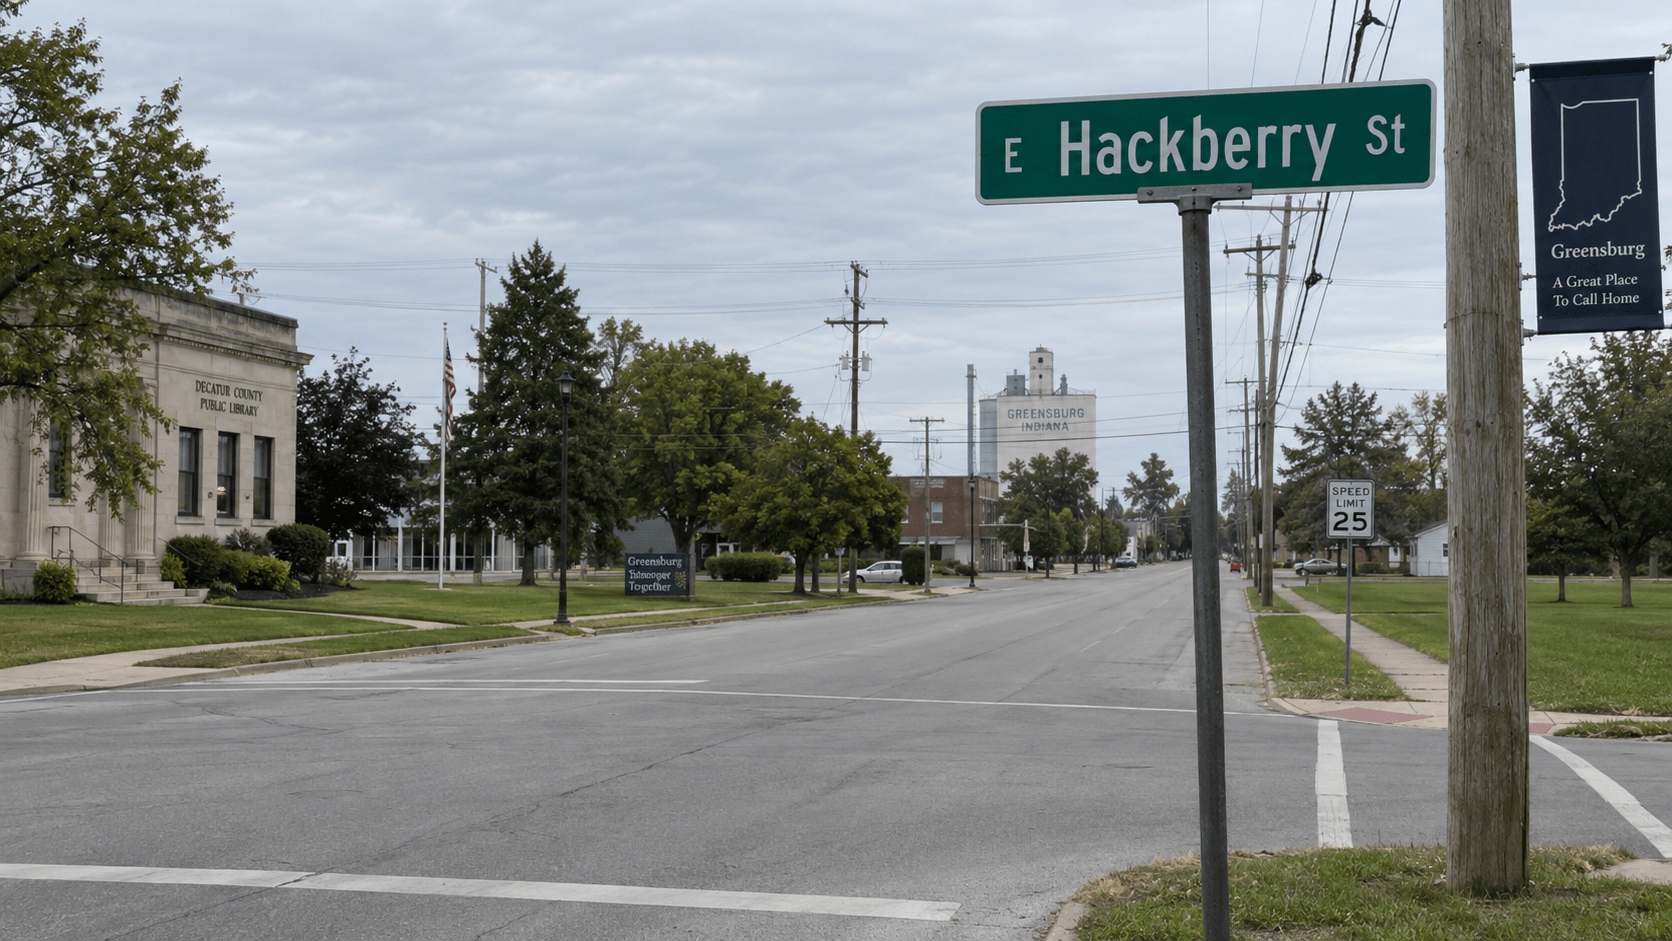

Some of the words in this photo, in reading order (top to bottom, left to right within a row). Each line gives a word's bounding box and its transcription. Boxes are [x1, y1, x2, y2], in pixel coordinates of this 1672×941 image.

[1004, 137, 1023, 173] E
[1060, 114, 1337, 182] Hackberry
[1365, 114, 1406, 155] St
[1551, 241, 1645, 260] Greensburg
[1552, 277, 1563, 288] A
[1566, 275, 1602, 288] Great
[1605, 273, 1638, 286] Place
[1553, 294, 1569, 307] To
[1572, 293, 1598, 306] Call
[1602, 292, 1640, 304] Home
[195, 380, 230, 397] DECATUR
[233, 387, 263, 402] COUNTY
[200, 398, 226, 413] PUBLIC
[229, 402, 259, 417] LIBRARY
[1007, 408, 1085, 419] GREENSBURG
[1021, 421, 1069, 432] INDIANA
[1332, 486, 1370, 496] SPEED
[1336, 499, 1366, 508] LIMIT
[1333, 511, 1367, 532] 25
[628, 556, 682, 569] Greensburg
